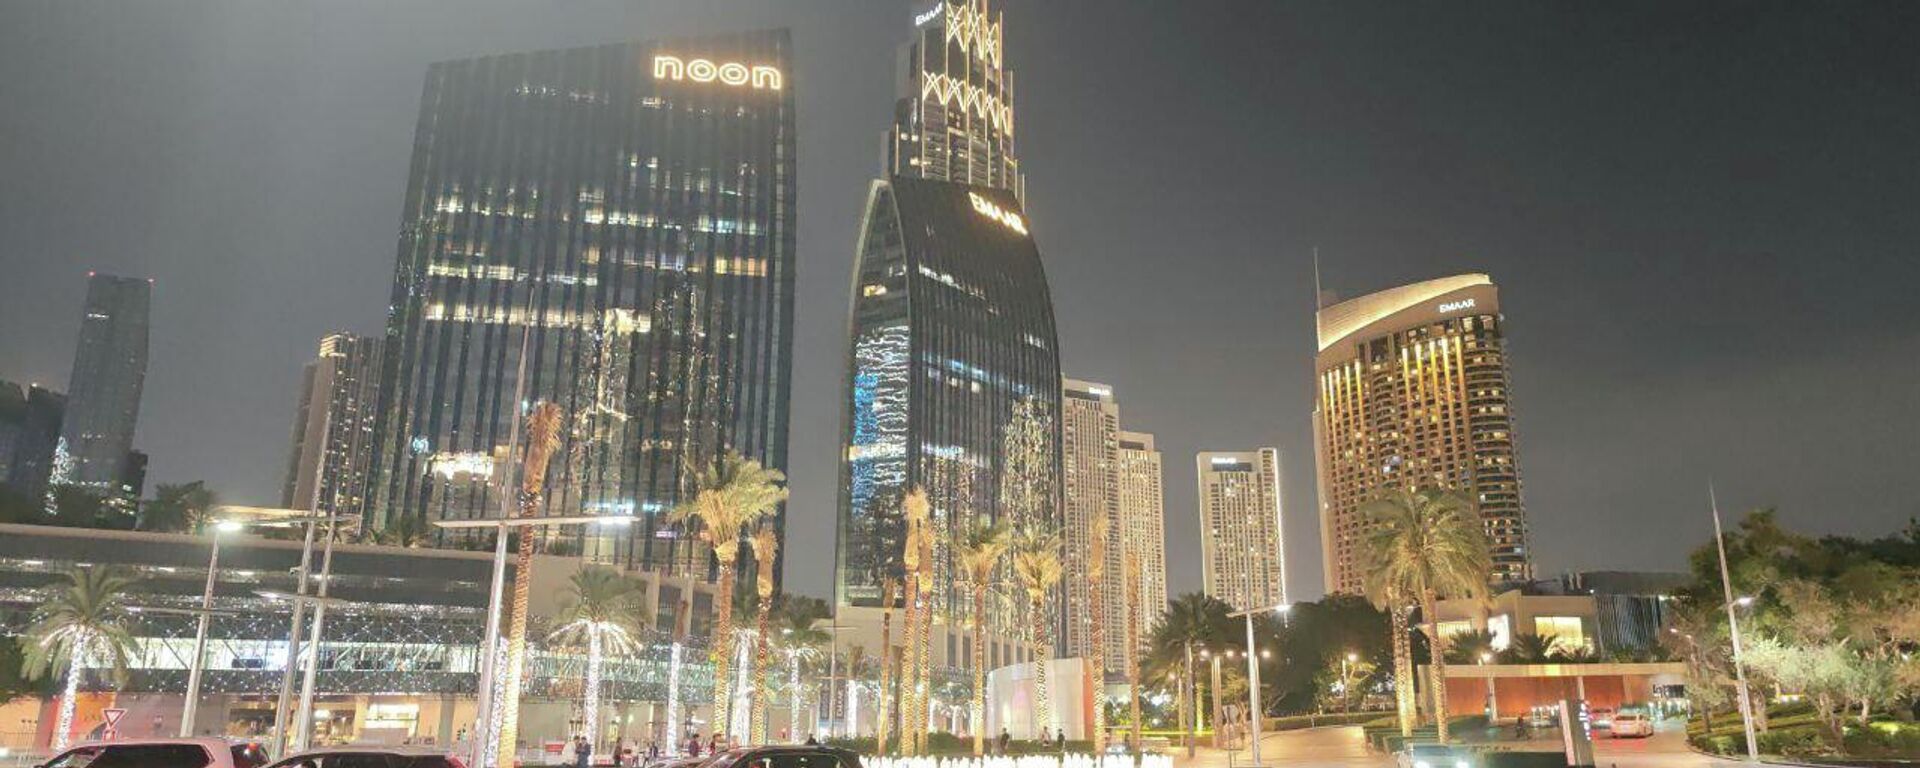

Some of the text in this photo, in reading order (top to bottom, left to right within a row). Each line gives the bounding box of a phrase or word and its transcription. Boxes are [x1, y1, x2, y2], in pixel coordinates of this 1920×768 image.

[654, 56, 781, 90] noon
[968, 191, 1028, 236] EMAAR
[1439, 298, 1476, 313] EMAAR
